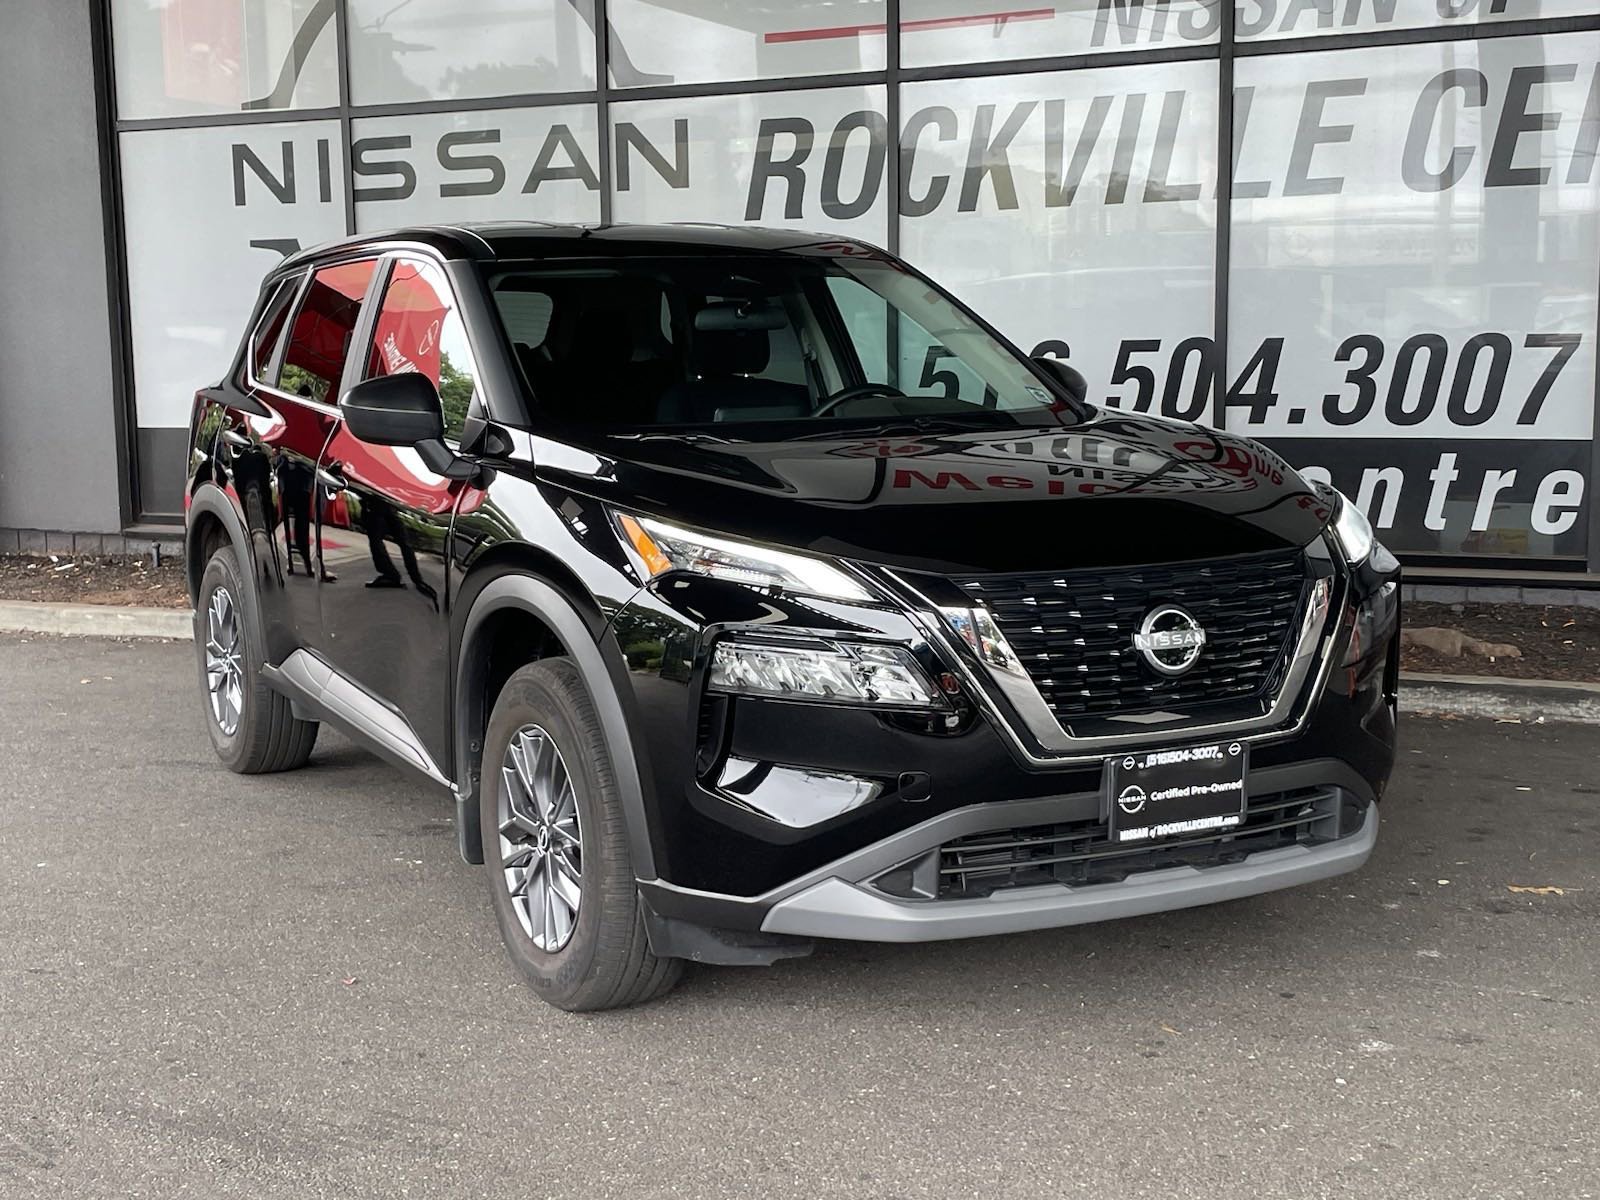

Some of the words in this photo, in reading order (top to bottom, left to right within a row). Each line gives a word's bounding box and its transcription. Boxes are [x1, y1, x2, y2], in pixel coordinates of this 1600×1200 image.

[744, 78, 1369, 221] ROCKVILLE
[232, 118, 690, 207] NISSAN
[1135, 630, 1205, 648] NISSAN
[1118, 794, 1147, 804] NISSAN
[1150, 786, 1190, 801] Certified
[1191, 779, 1243, 796] Pre-Owned
[1119, 827, 1149, 842] NISSAN
